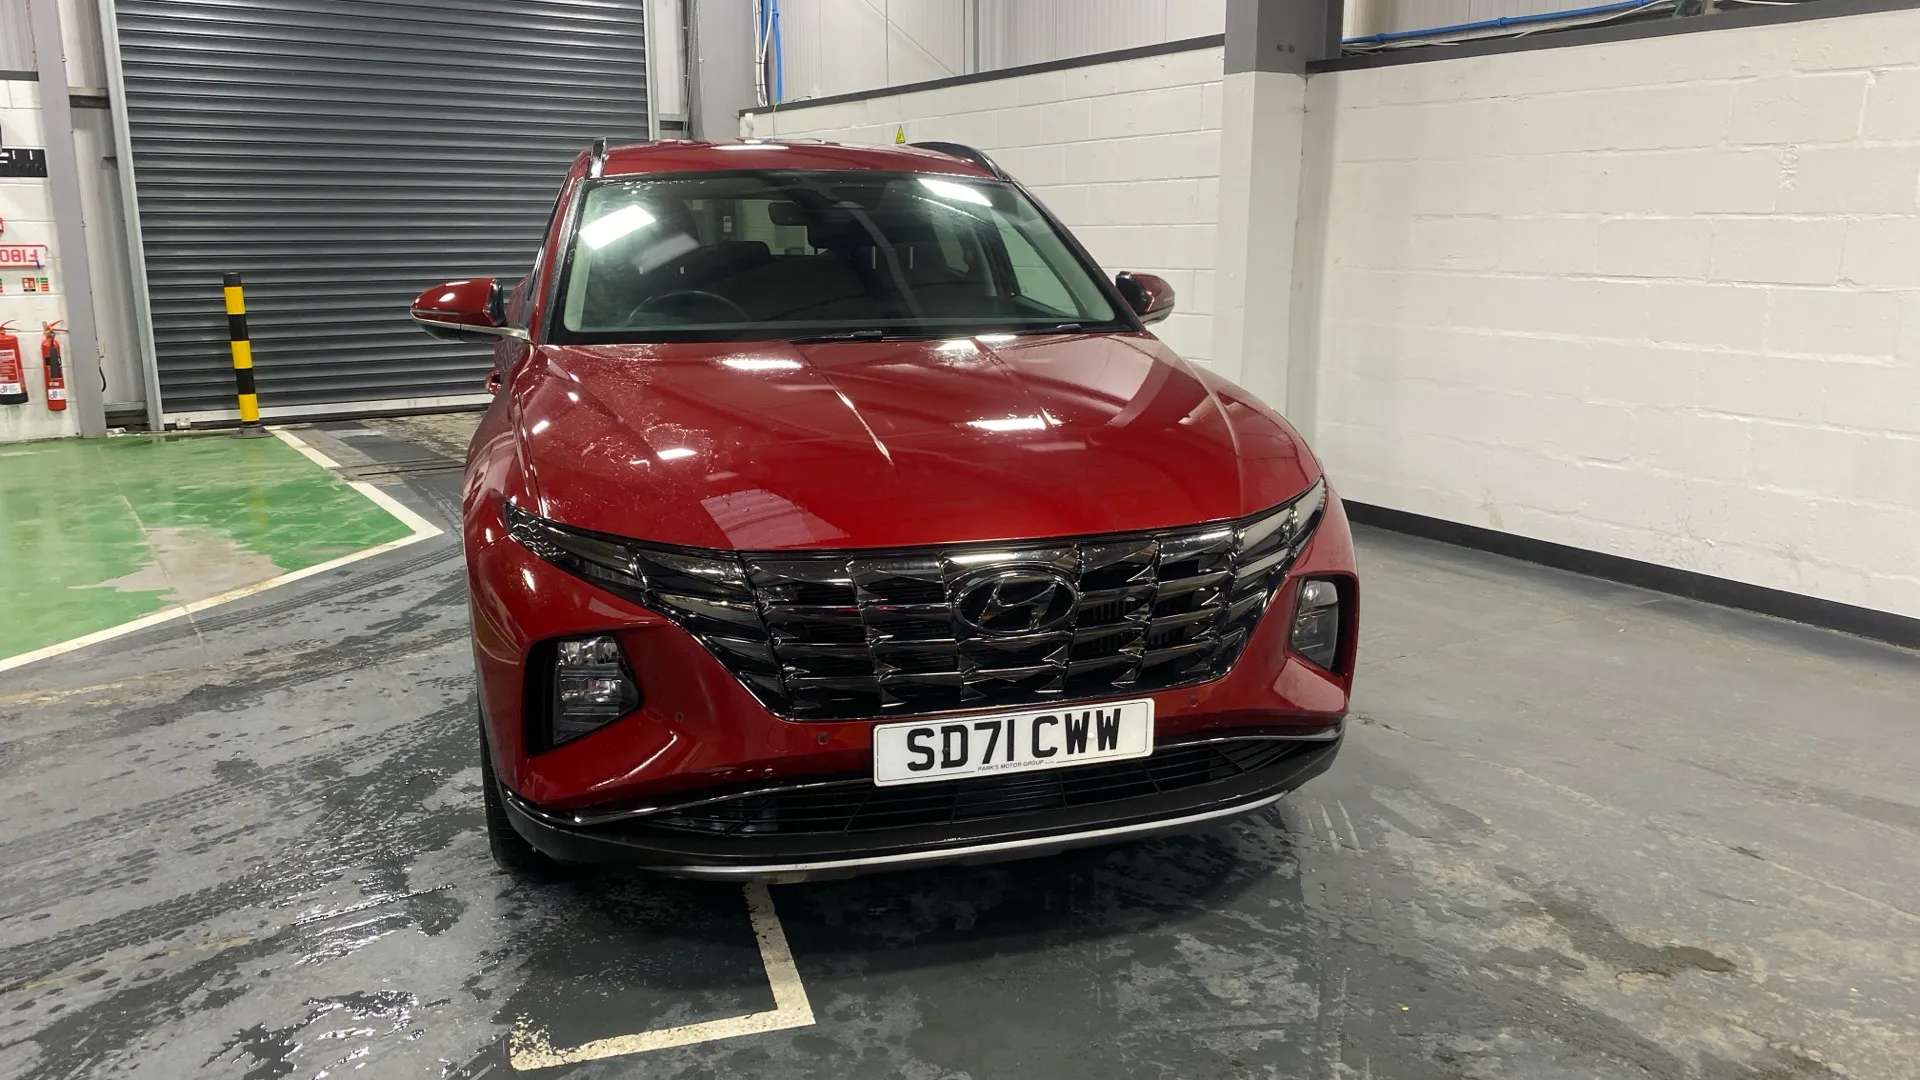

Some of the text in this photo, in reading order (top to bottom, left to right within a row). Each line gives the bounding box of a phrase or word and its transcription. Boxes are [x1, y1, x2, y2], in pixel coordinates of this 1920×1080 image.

[906, 708, 1122, 773] SD71 CWW
[1000, 761, 1022, 769] MOTOR
[1023, 759, 1044, 767] GROUP
